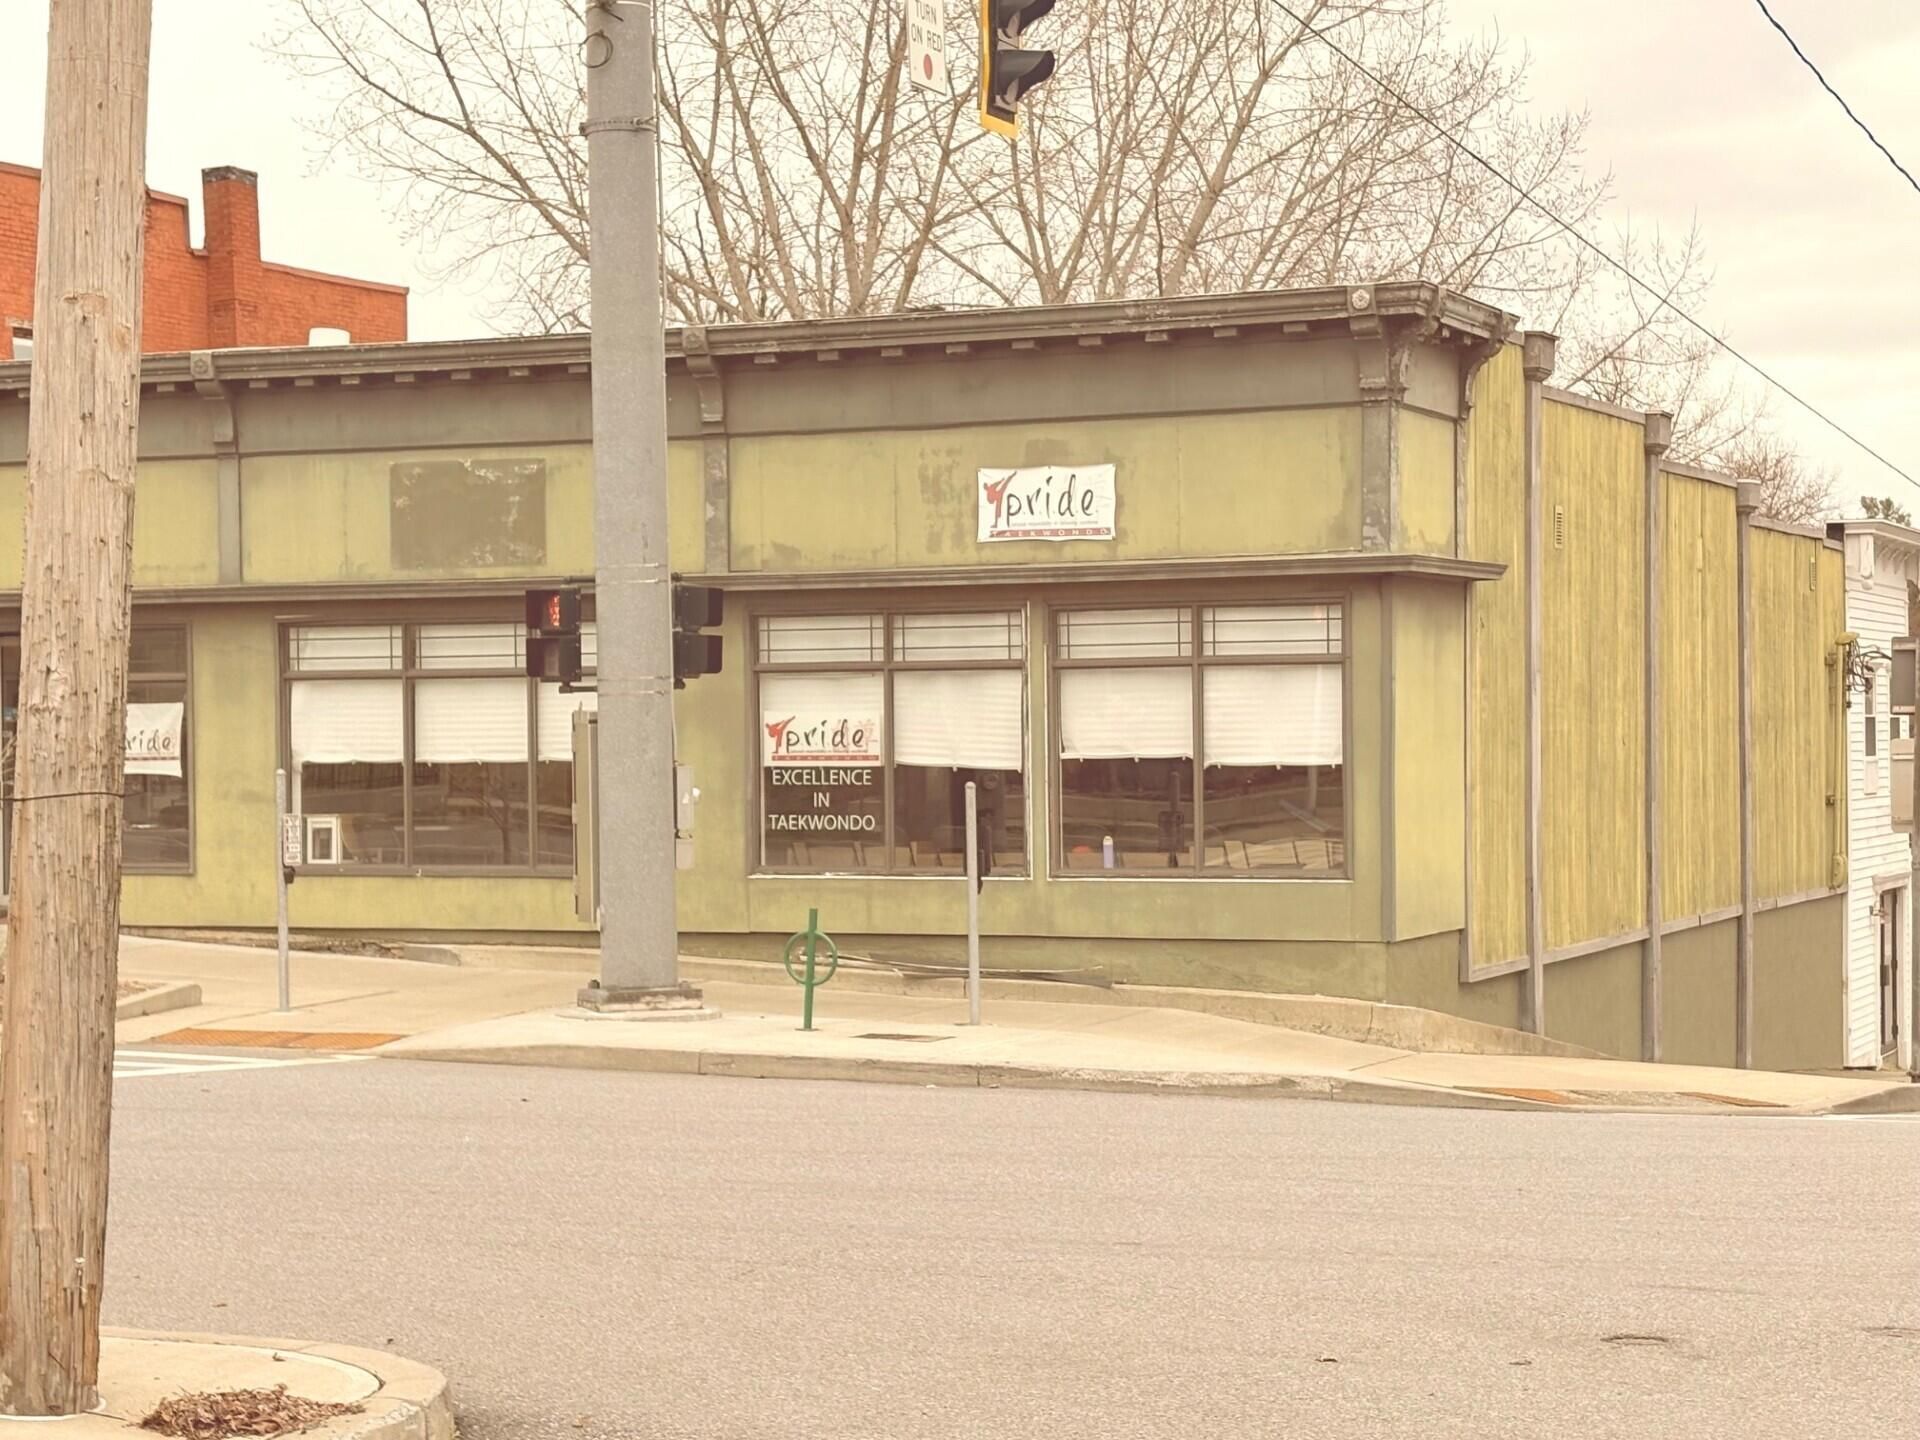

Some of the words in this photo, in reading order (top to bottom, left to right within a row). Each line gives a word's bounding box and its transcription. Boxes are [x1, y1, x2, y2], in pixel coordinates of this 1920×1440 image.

[914, 0, 937, 24] TURN
[911, 23, 923, 45] ON
[926, 30, 943, 52] RED
[125, 728, 171, 753] ride
[772, 769, 872, 785] EXCELLENCE
[813, 792, 830, 808] IN
[768, 814, 876, 831] TAEKWONDO
